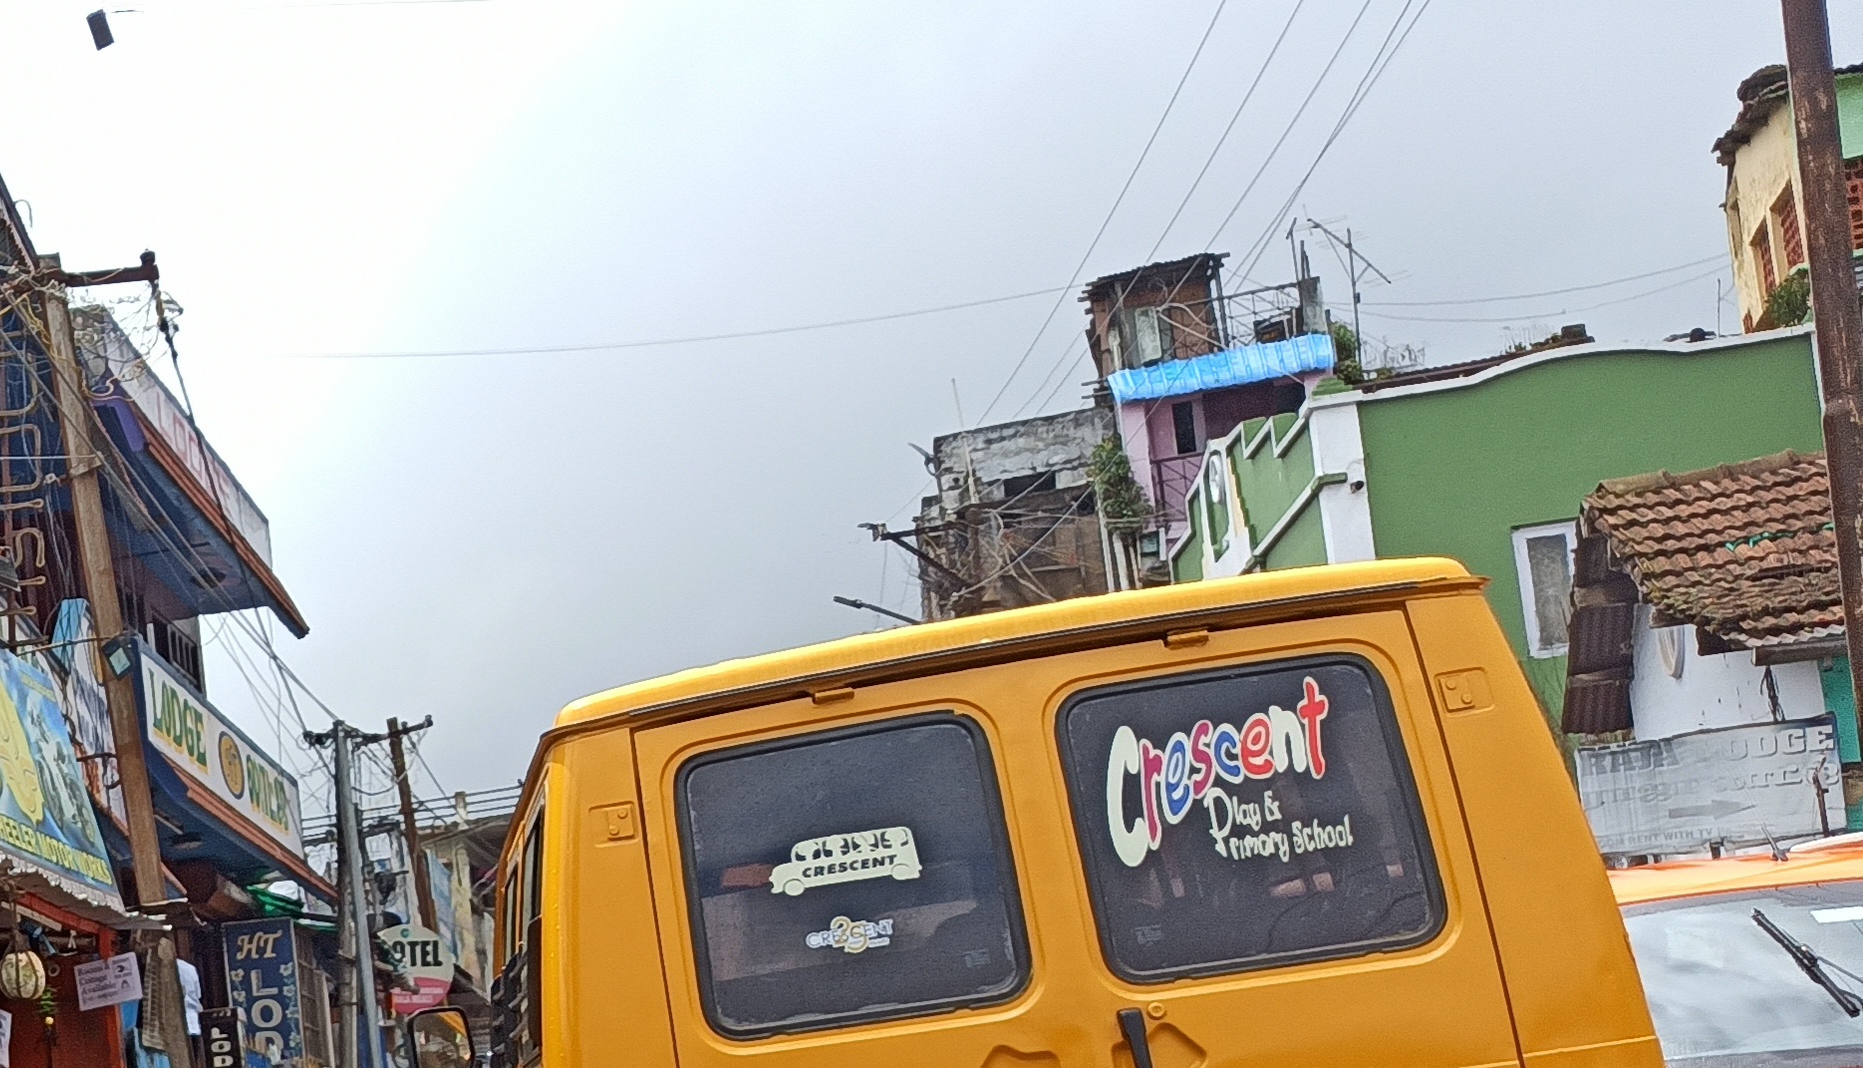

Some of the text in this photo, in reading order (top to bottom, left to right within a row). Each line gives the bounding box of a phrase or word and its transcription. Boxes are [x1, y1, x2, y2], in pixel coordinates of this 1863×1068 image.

[147, 667, 208, 775] LODGE
[1107, 676, 1329, 868] Crescent
[1291, 814, 1354, 854] School
[801, 854, 898, 879] CRESCENT
[237, 929, 283, 960] HT
[391, 939, 444, 967] OTEL
